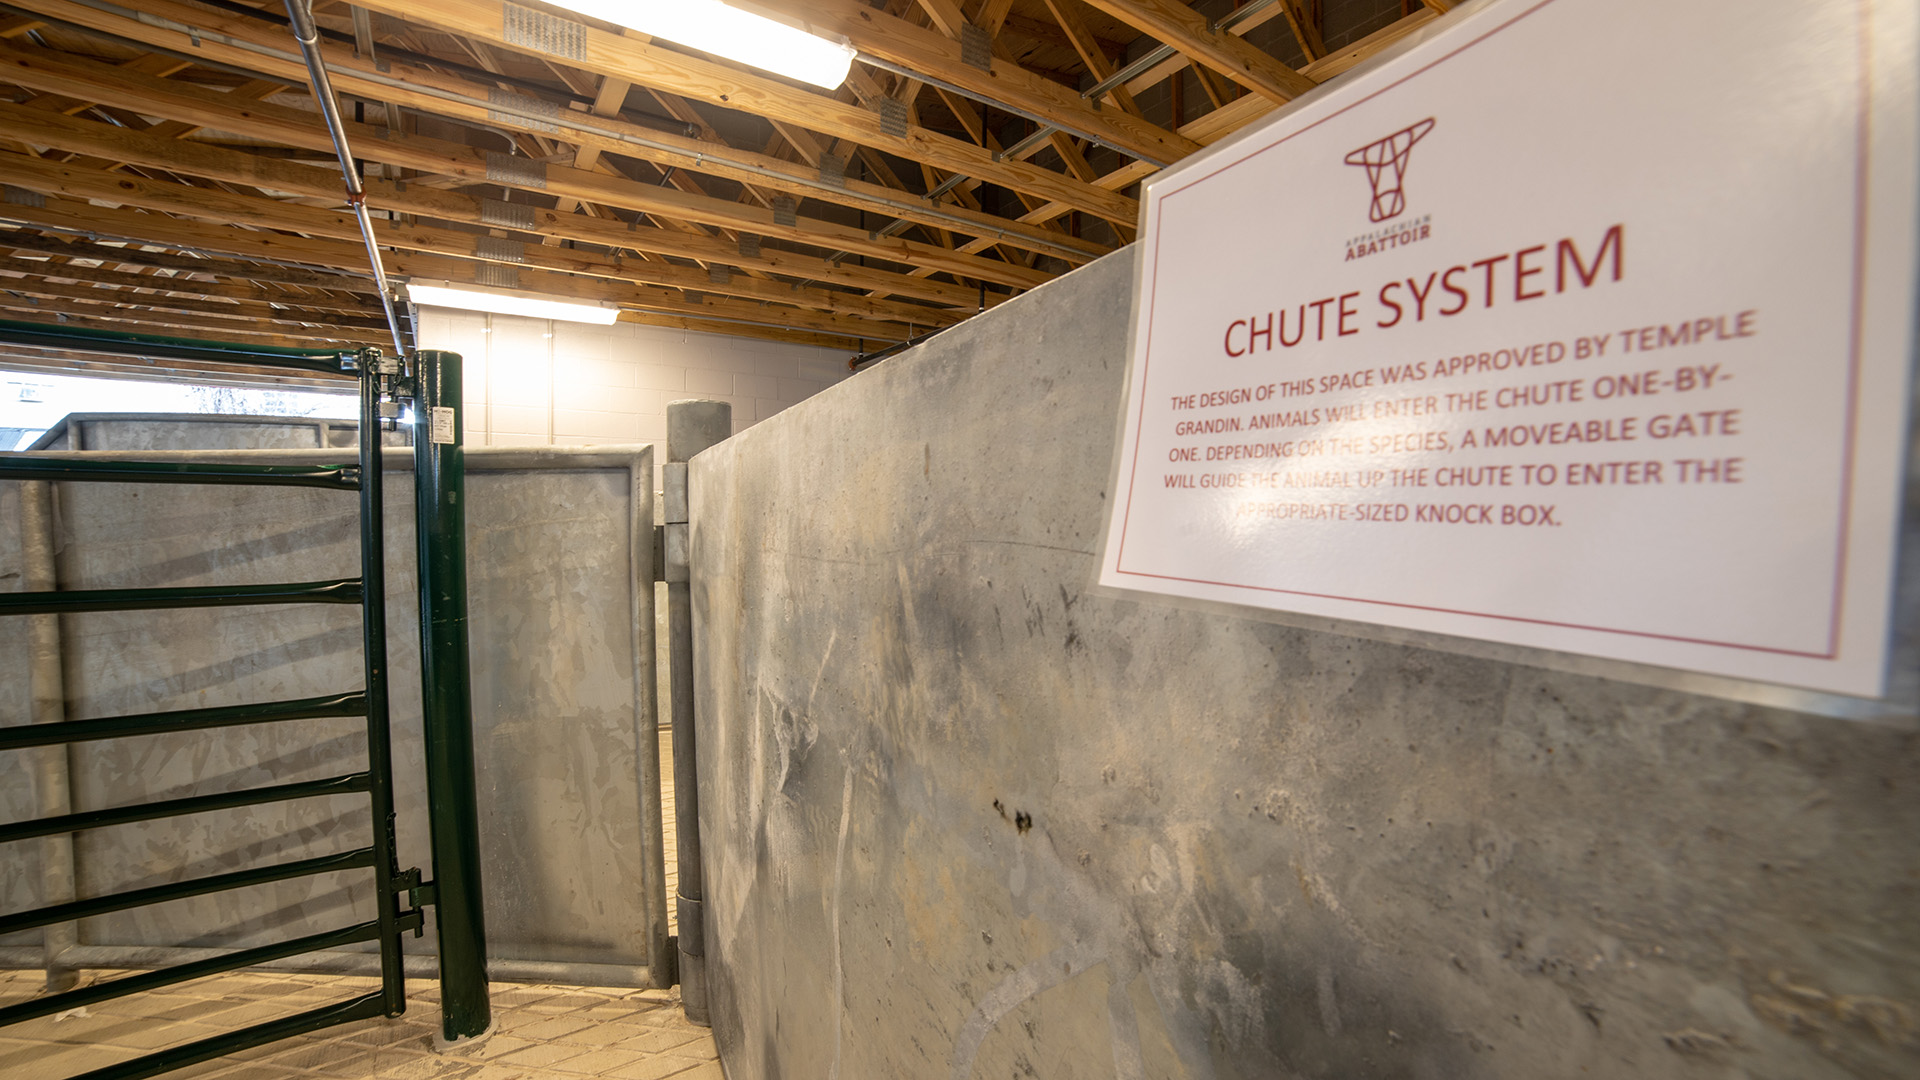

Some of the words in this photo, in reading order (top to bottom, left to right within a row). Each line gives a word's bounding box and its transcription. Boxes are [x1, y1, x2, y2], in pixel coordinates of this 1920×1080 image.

[1345, 225, 1431, 262] ABATTOIR
[1346, 214, 1431, 247] APPALACHIAN
[1224, 291, 1360, 357] CHUTE
[1377, 223, 1624, 328] SYSTEM
[1171, 395, 1196, 410] THE
[1200, 388, 1251, 408] DESIGN
[1256, 384, 1276, 401] OF
[1280, 378, 1315, 398] THIS
[1319, 369, 1374, 393] SPACE
[1380, 361, 1427, 384] WAS
[1433, 341, 1566, 378] APPROVED
[1574, 333, 1611, 360] BY
[1618, 309, 1759, 354] TEMPLE
[1175, 417, 1245, 436] GRANDIN.
[1248, 408, 1320, 430] ANIMALS
[1325, 402, 1367, 423] WILL
[1373, 396, 1438, 419] ENTER
[1445, 390, 1488, 412] THE
[1495, 379, 1585, 408] CHUTE
[1592, 362, 1735, 400] ONE-BY-
[1168, 447, 1202, 462] ONE.
[1206, 441, 1294, 461] DEPENDING
[1297, 439, 1324, 457] ON
[1329, 436, 1364, 455] THE
[1369, 431, 1454, 454] SPECIES,
[1460, 429, 1477, 449] A
[1484, 416, 1638, 448] MOVEABLE
[1647, 408, 1742, 439] GATE
[1164, 474, 1196, 488] WILL
[1200, 473, 1248, 488] GUIDE
[1251, 472, 1280, 488] THE
[1283, 471, 1351, 488] ANIMAL
[1357, 470, 1385, 488] UP
[1390, 468, 1429, 487] THE
[1435, 465, 1513, 487] CHUTE
[1520, 463, 1557, 486] TO
[1566, 460, 1664, 485] ENTER
[1673, 457, 1746, 484] THE
[1236, 502, 1409, 522] APPROPRIATE-SIZED
[1415, 504, 1494, 525] KNOCK
[1501, 503, 1562, 527] BOX.
